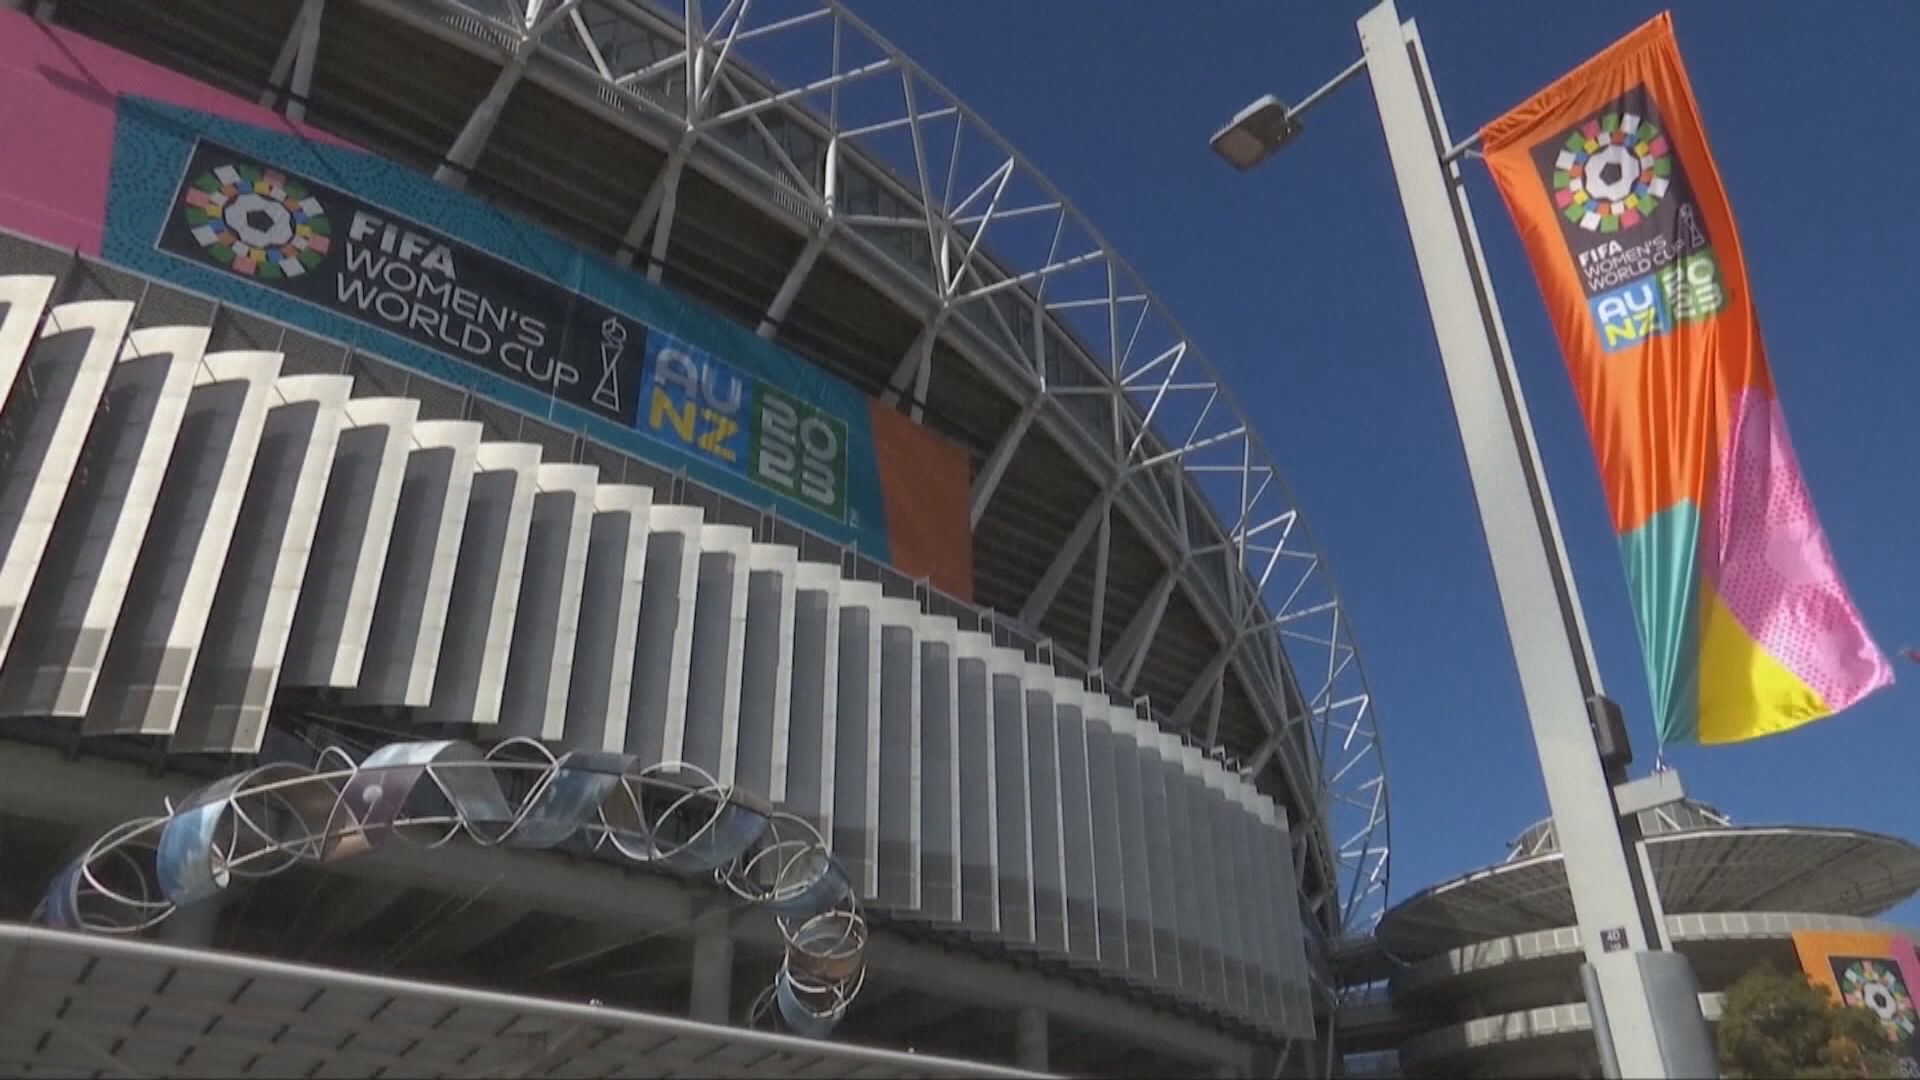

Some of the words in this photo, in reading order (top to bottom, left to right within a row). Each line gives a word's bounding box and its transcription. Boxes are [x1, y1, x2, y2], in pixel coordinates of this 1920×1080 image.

[350, 210, 456, 280] FIFA
[1578, 240, 1622, 267] FIFA
[1583, 234, 1667, 280] WOMEN'S
[1587, 258, 1652, 293] WORLD
[1653, 239, 1685, 266] CUP
[345, 241, 546, 348] WOMEN'S
[1598, 283, 1654, 324] AU
[337, 272, 492, 355] WORLD
[500, 342, 580, 388] CUP
[1604, 306, 1658, 347] NZ
[654, 347, 742, 414] AU
[649, 386, 738, 463] NZ
